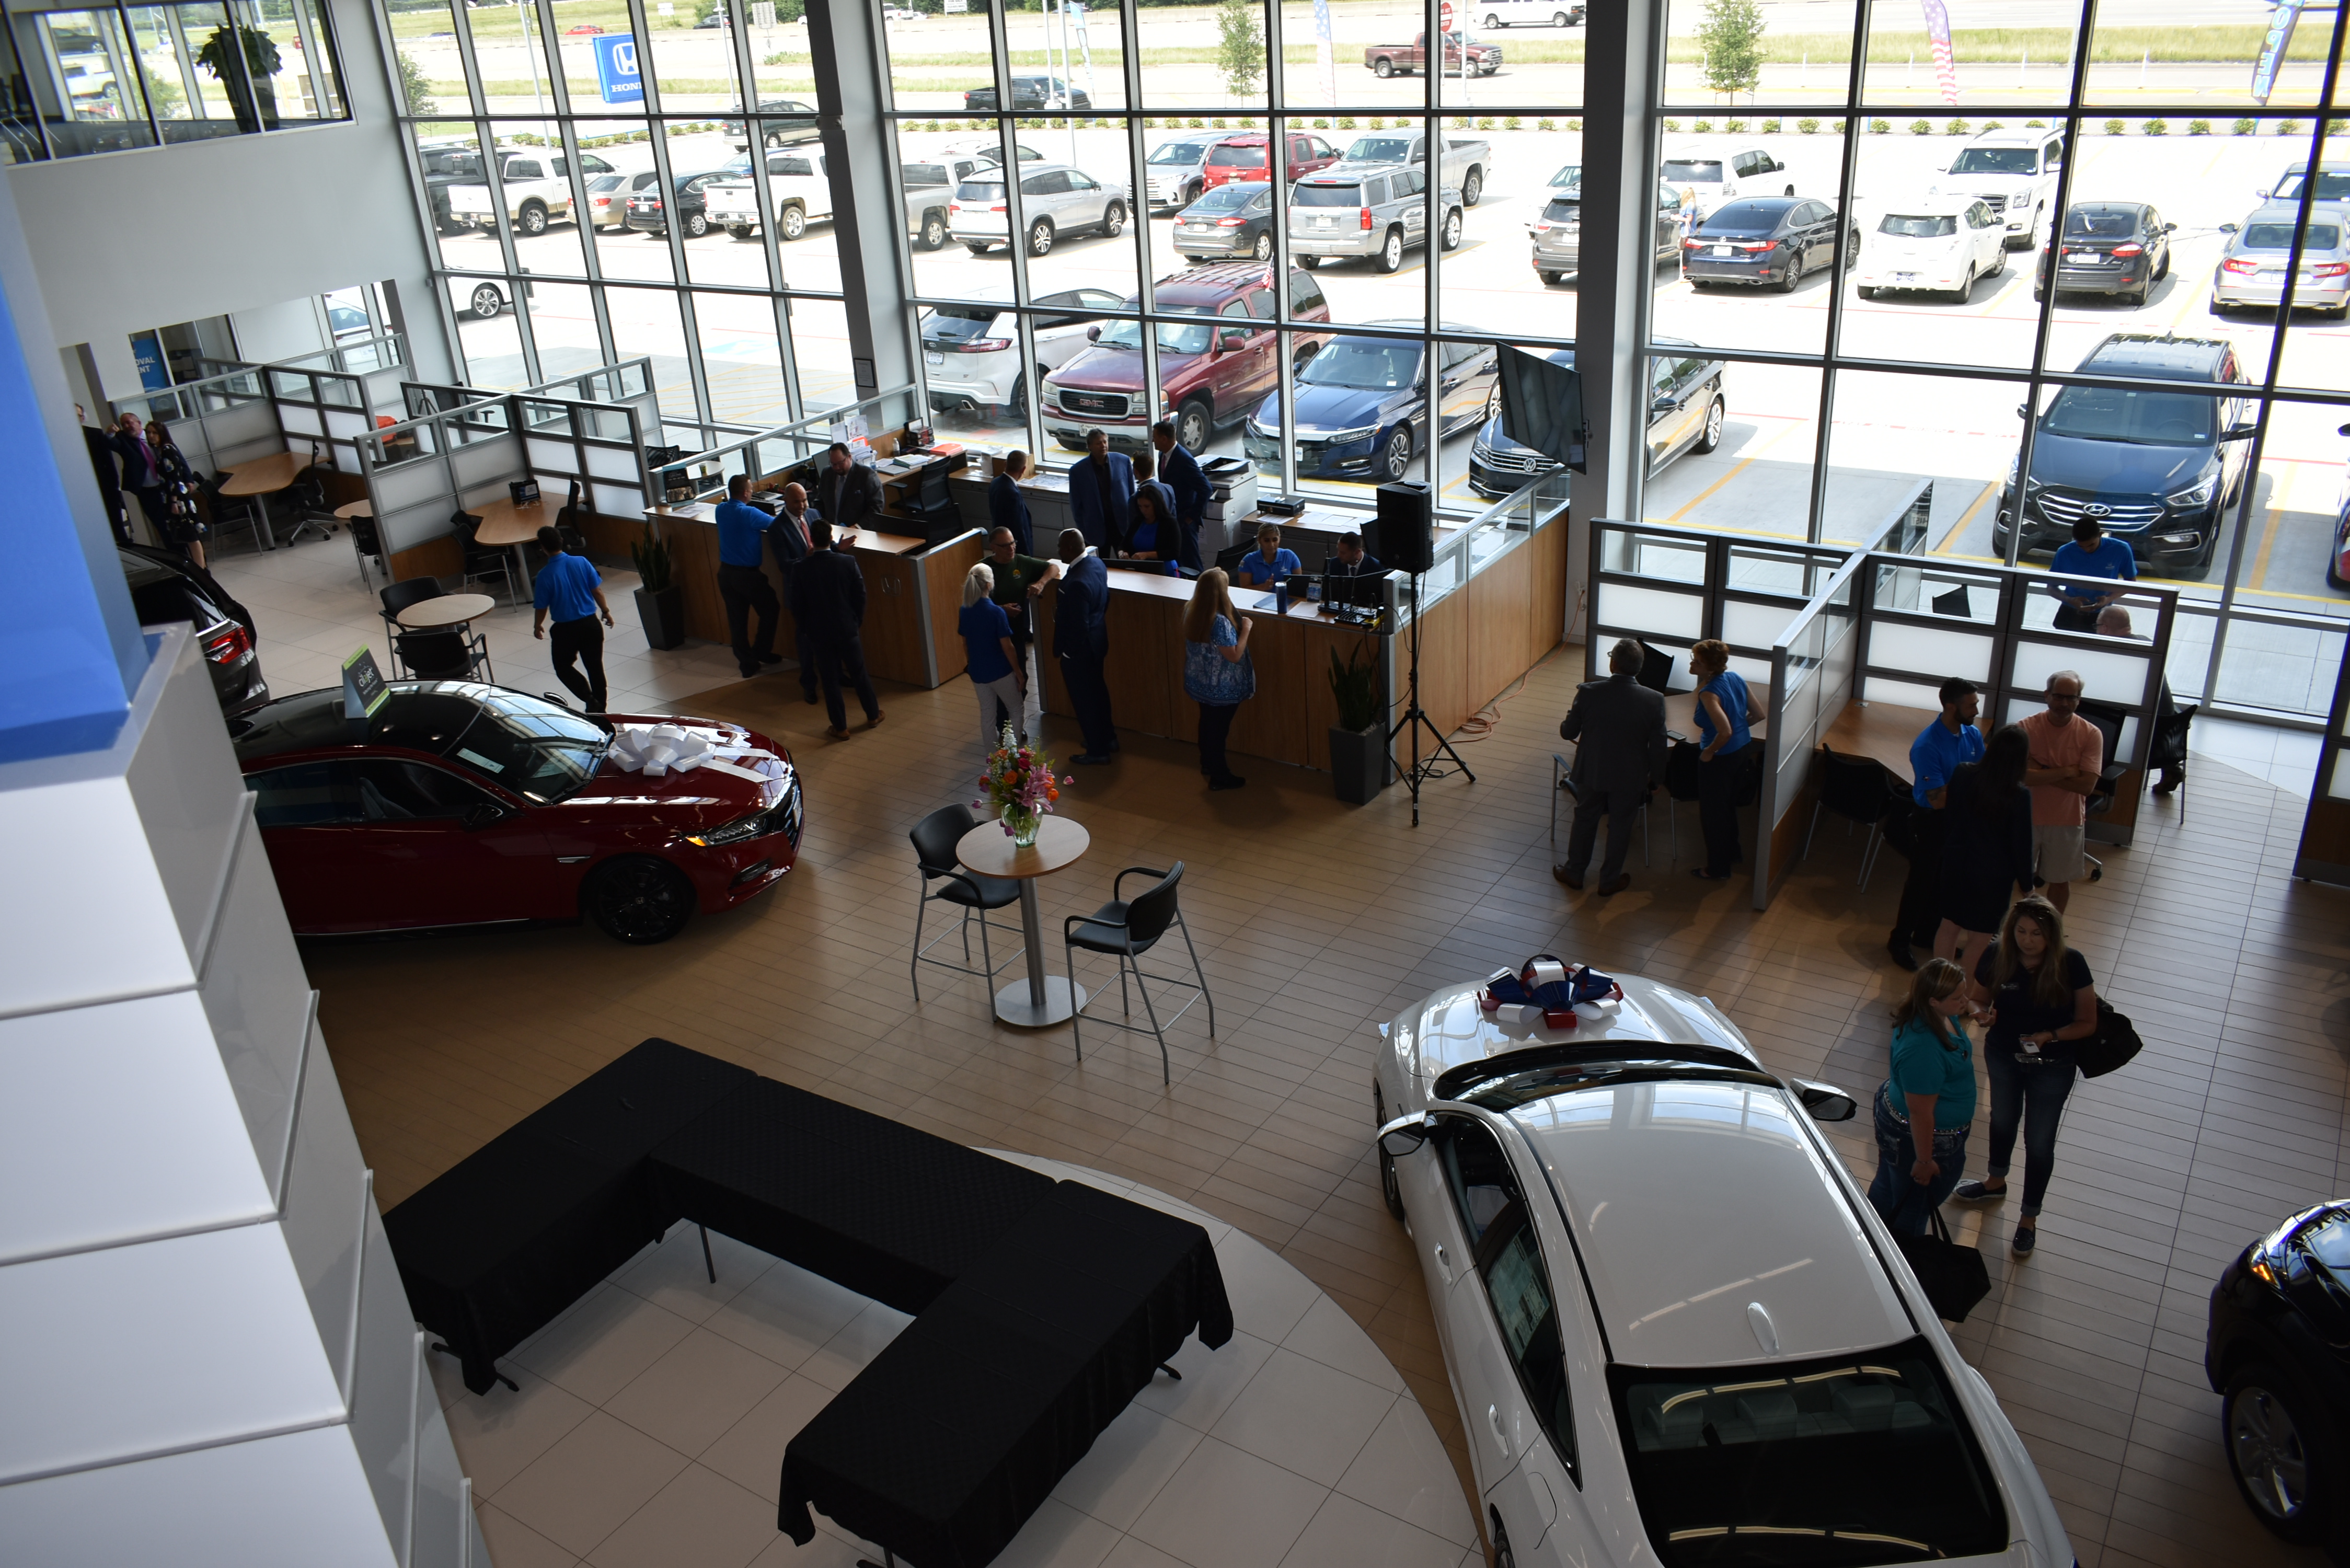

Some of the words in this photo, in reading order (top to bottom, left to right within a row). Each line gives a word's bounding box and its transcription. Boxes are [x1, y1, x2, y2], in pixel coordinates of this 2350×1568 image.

[611, 82, 642, 93] HON
[135, 356, 155, 366] OVAL
[1080, 398, 1104, 408] GMC
